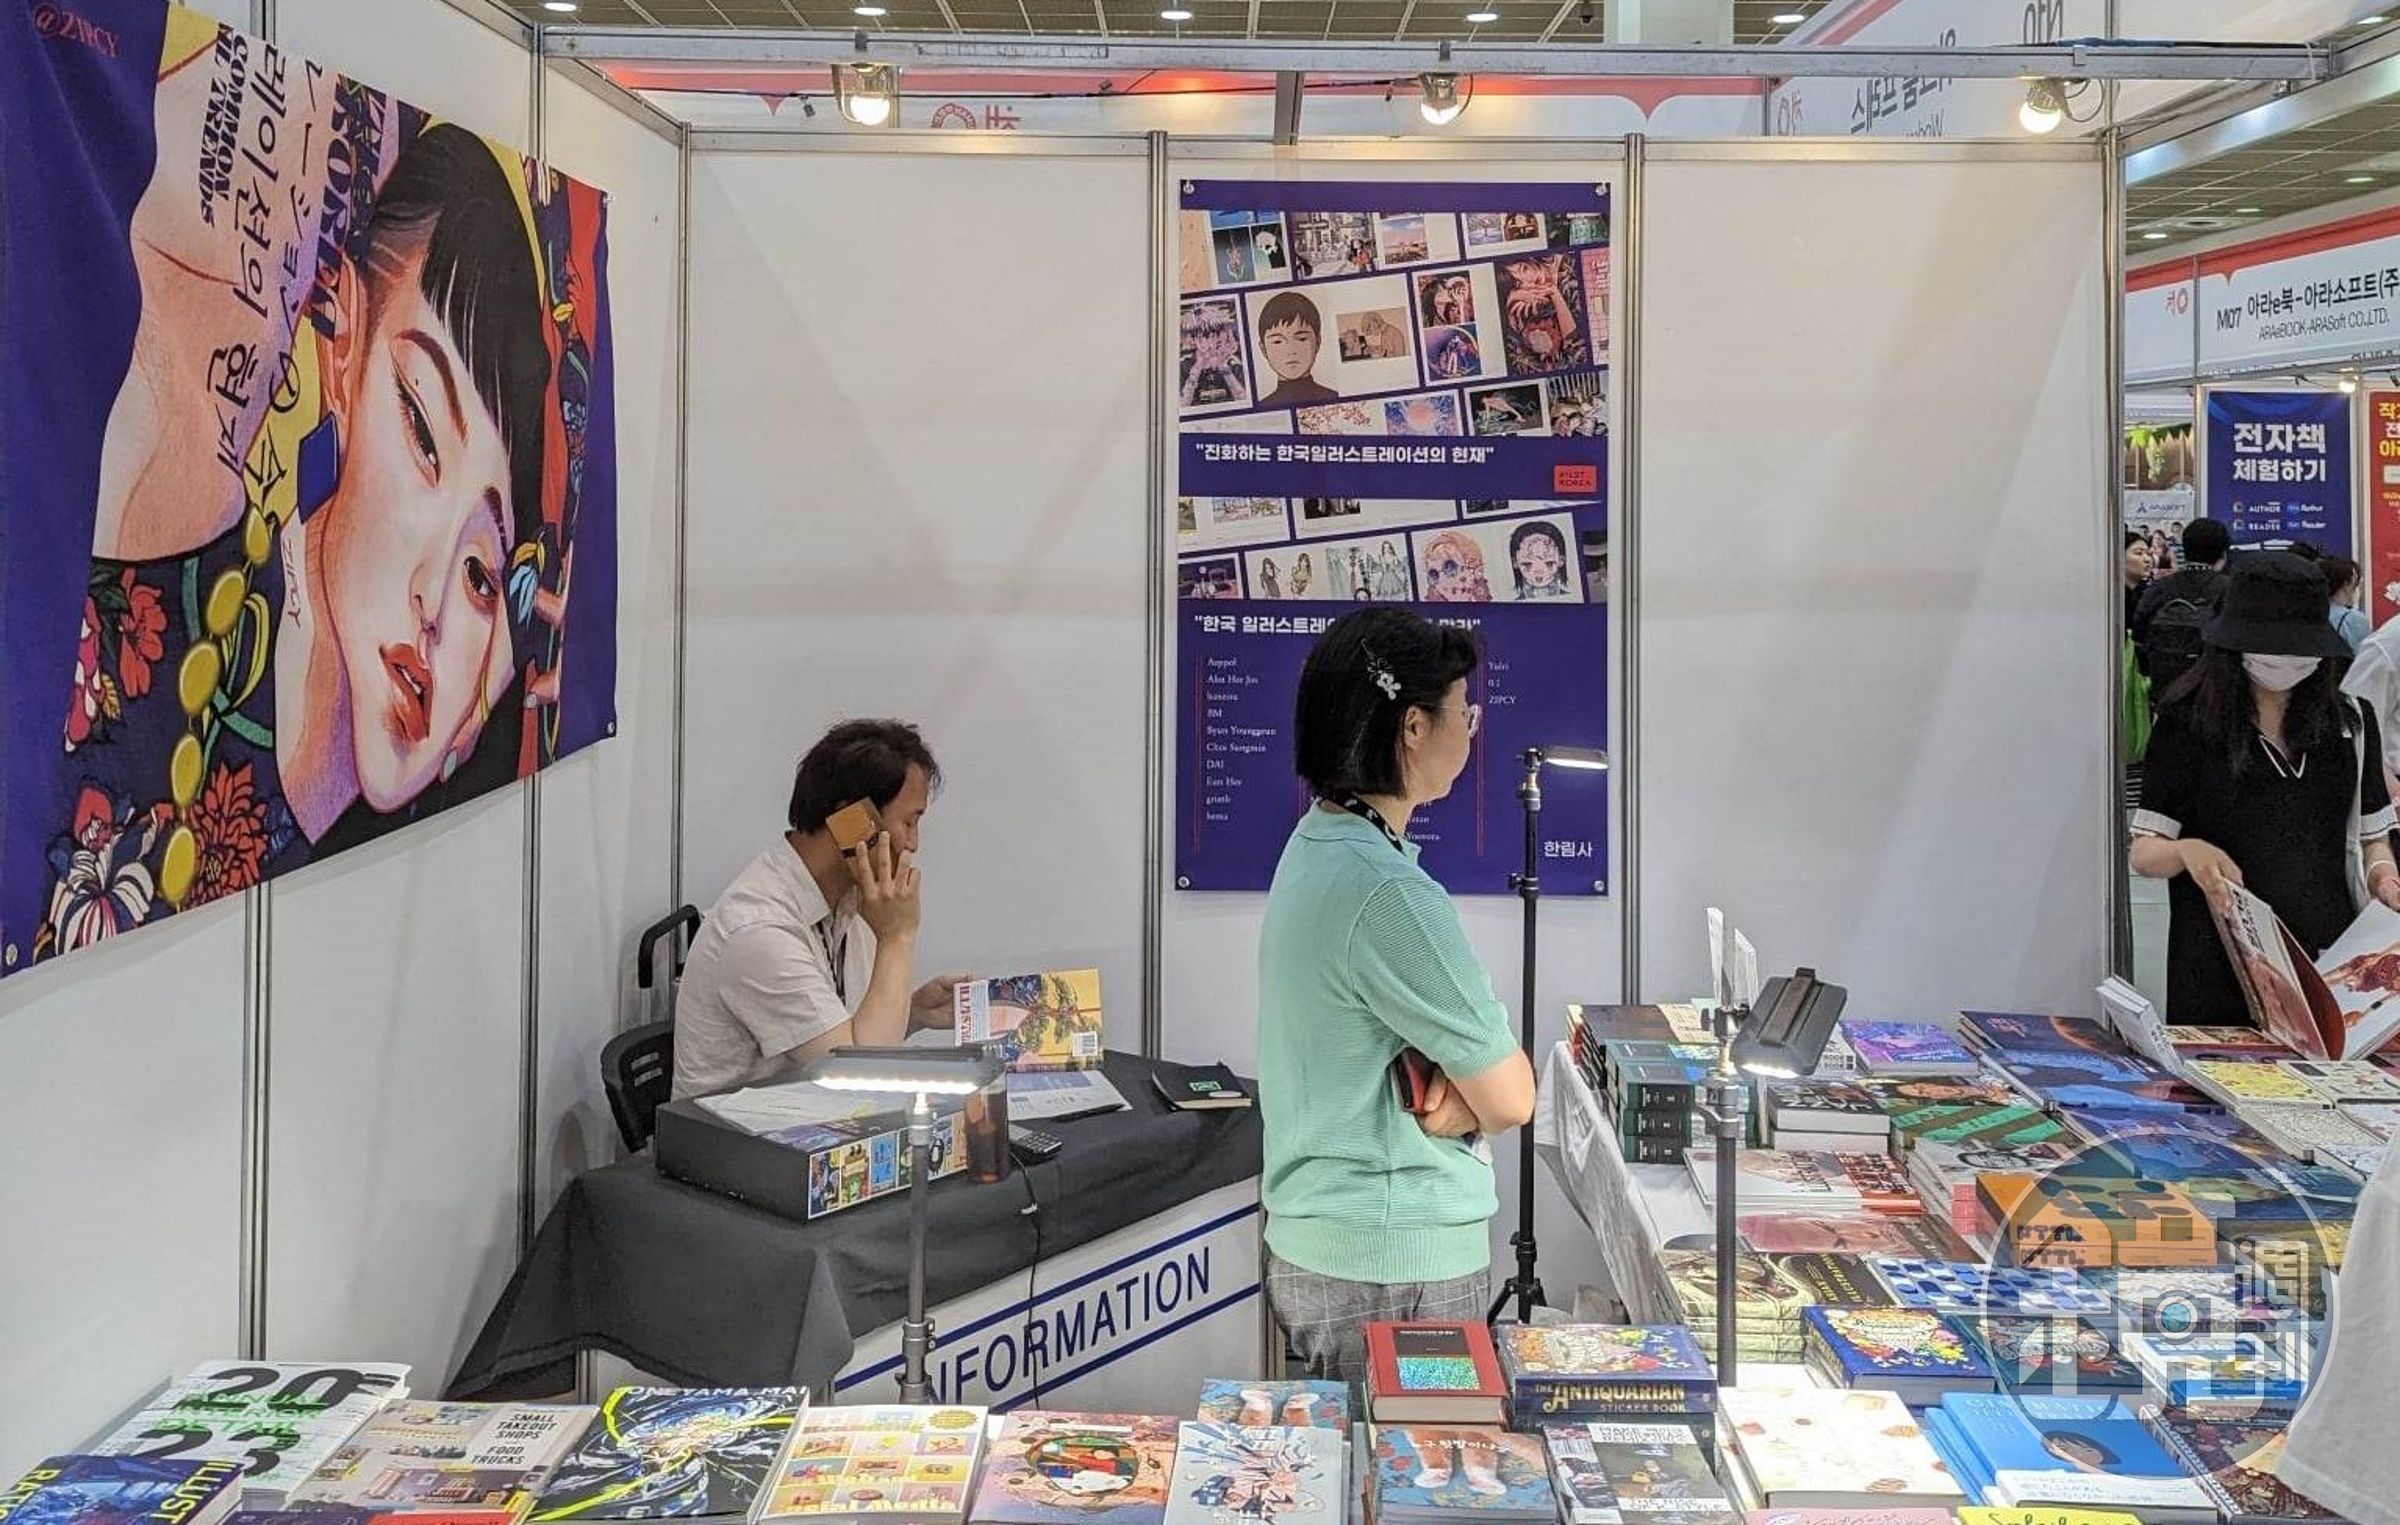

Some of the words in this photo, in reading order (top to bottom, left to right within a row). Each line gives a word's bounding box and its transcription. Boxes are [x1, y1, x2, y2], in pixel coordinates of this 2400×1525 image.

[215, 34, 248, 201] COMMON
[2216, 307, 2242, 331] M07
[207, 343, 259, 477] 현재
[2232, 422, 2326, 453] 전자책
[1195, 443, 1271, 462] "진화하는
[1276, 444, 1446, 463] 한국일러스트레이션의
[1451, 446, 1494, 464] 현재"
[2232, 459, 2326, 482] 체험하기
[1194, 615, 1236, 633] "한국
[1543, 840, 1593, 859] 한림사
[928, 1246, 1210, 1404] NFORMATION
[1542, 1384, 1686, 1413] ANTIQUARIAN
[1653, 1403, 1686, 1413] BOOK
[496, 1421, 558, 1431] TAKEOUT
[509, 1413, 556, 1422] SMALL
[494, 1430, 542, 1440] SHOPS
[471, 1455, 526, 1465] TRUCKS
[487, 1446, 525, 1455] FOOD
